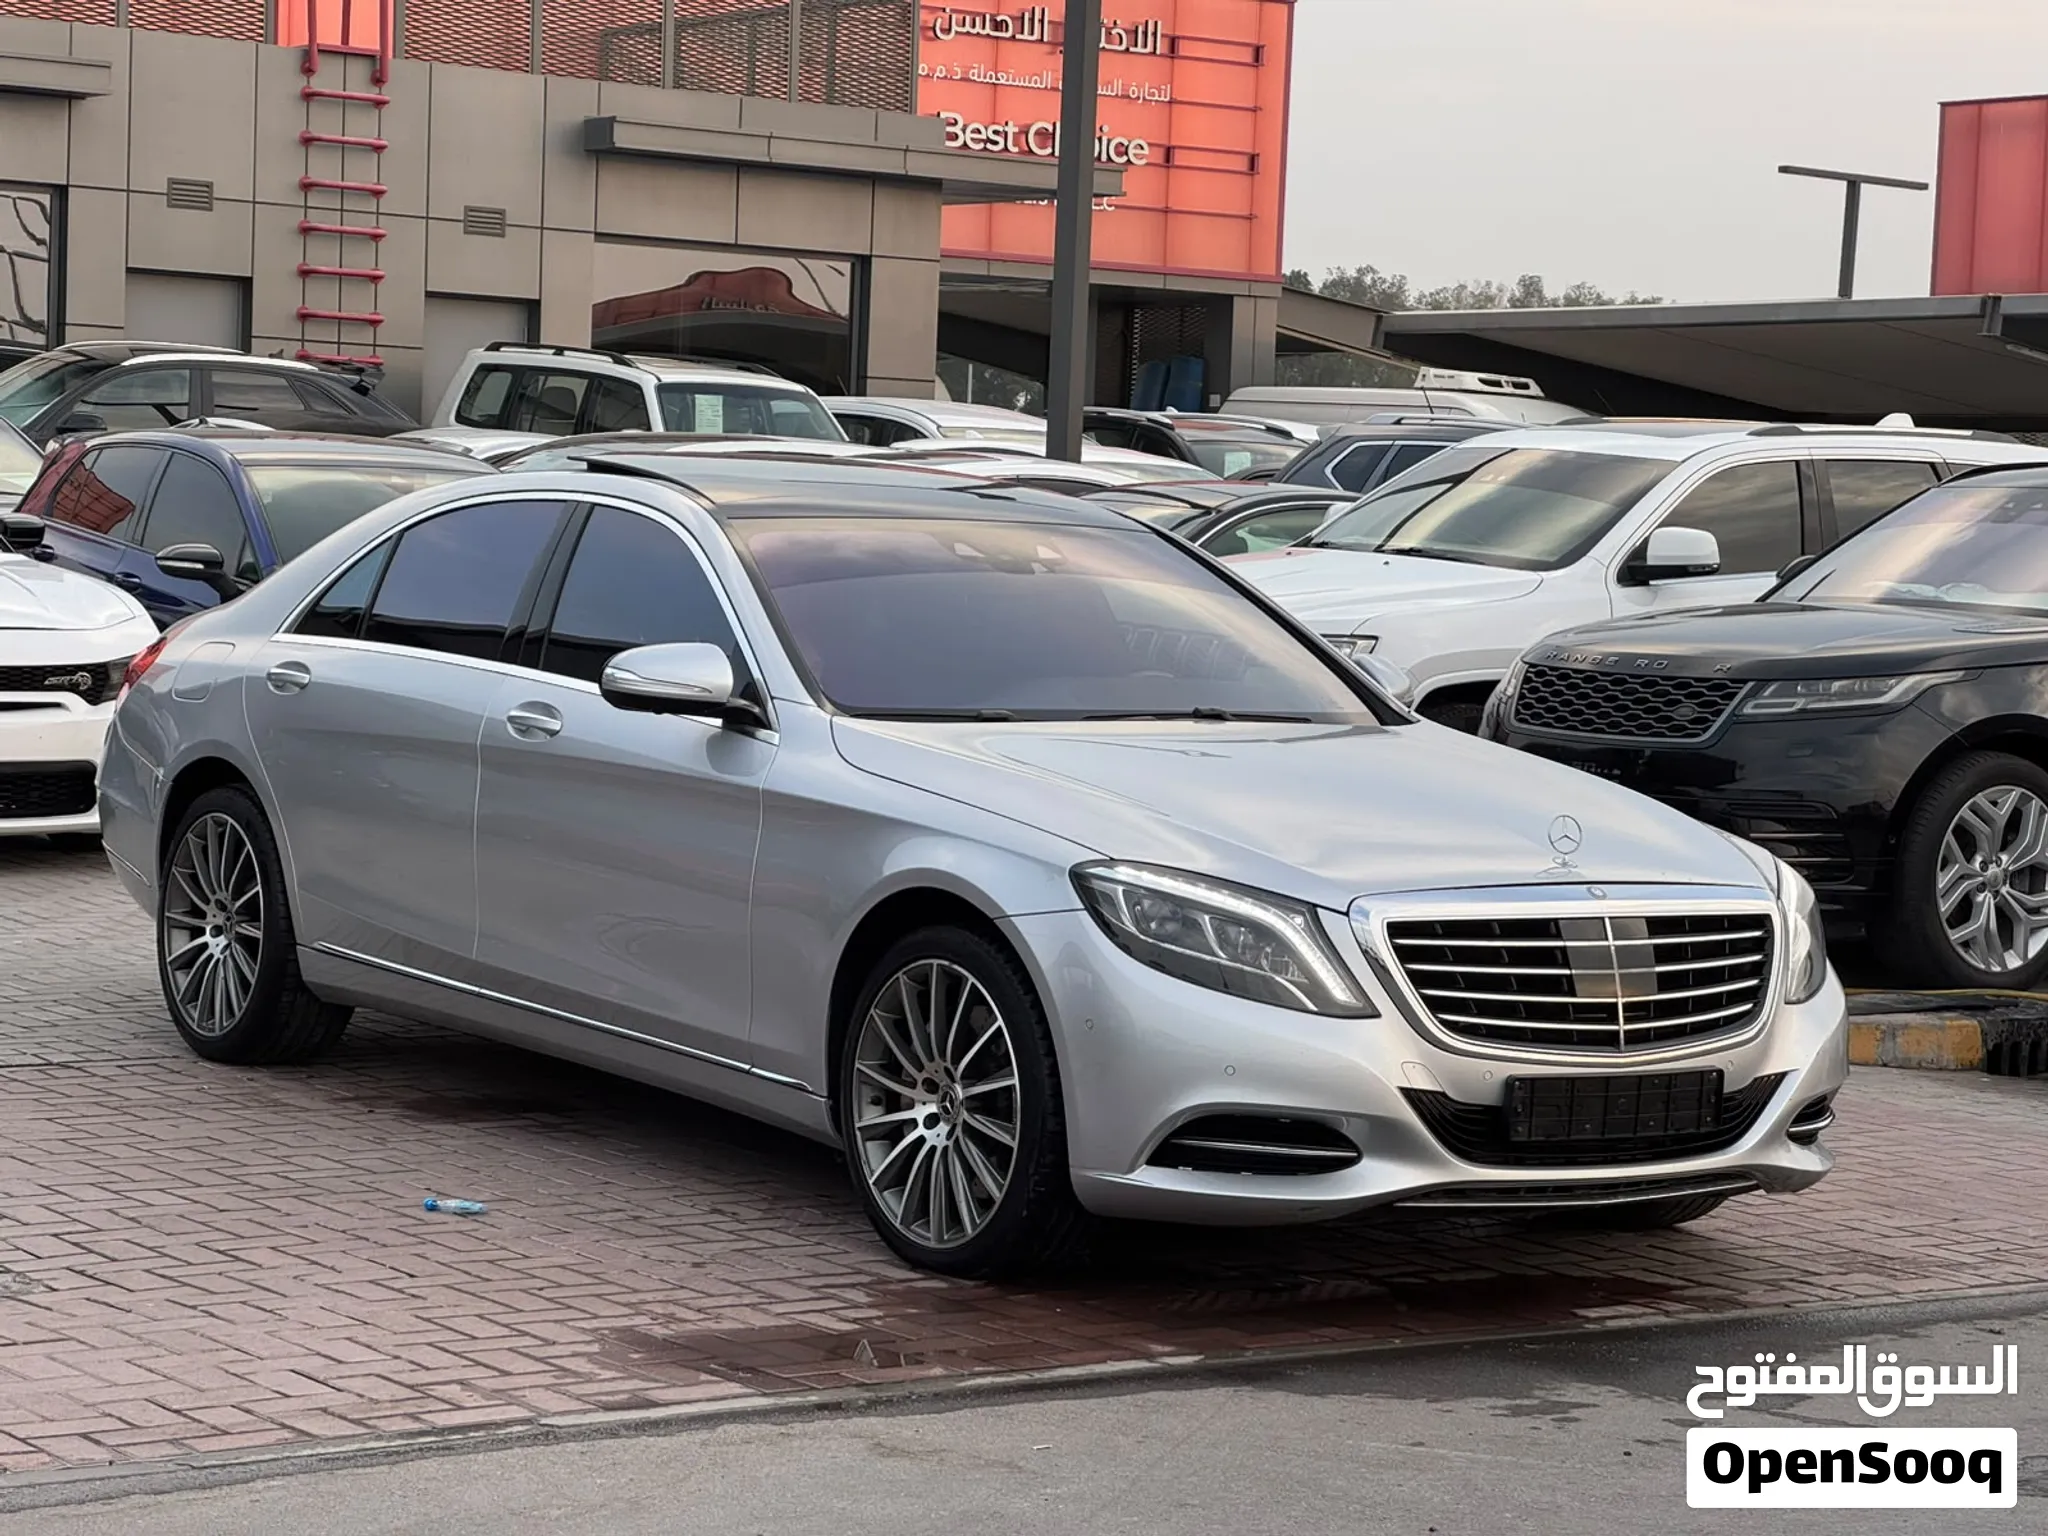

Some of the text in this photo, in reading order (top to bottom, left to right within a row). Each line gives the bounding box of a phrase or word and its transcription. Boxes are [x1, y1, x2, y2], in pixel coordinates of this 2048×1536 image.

[933, 6, 1049, 42] الاحسن
[968, 62, 1052, 90] المستعملة
[1128, 81, 1171, 105] لتجارة
[938, 111, 1150, 165] Best Cice
[1545, 650, 1620, 666] RANGE
